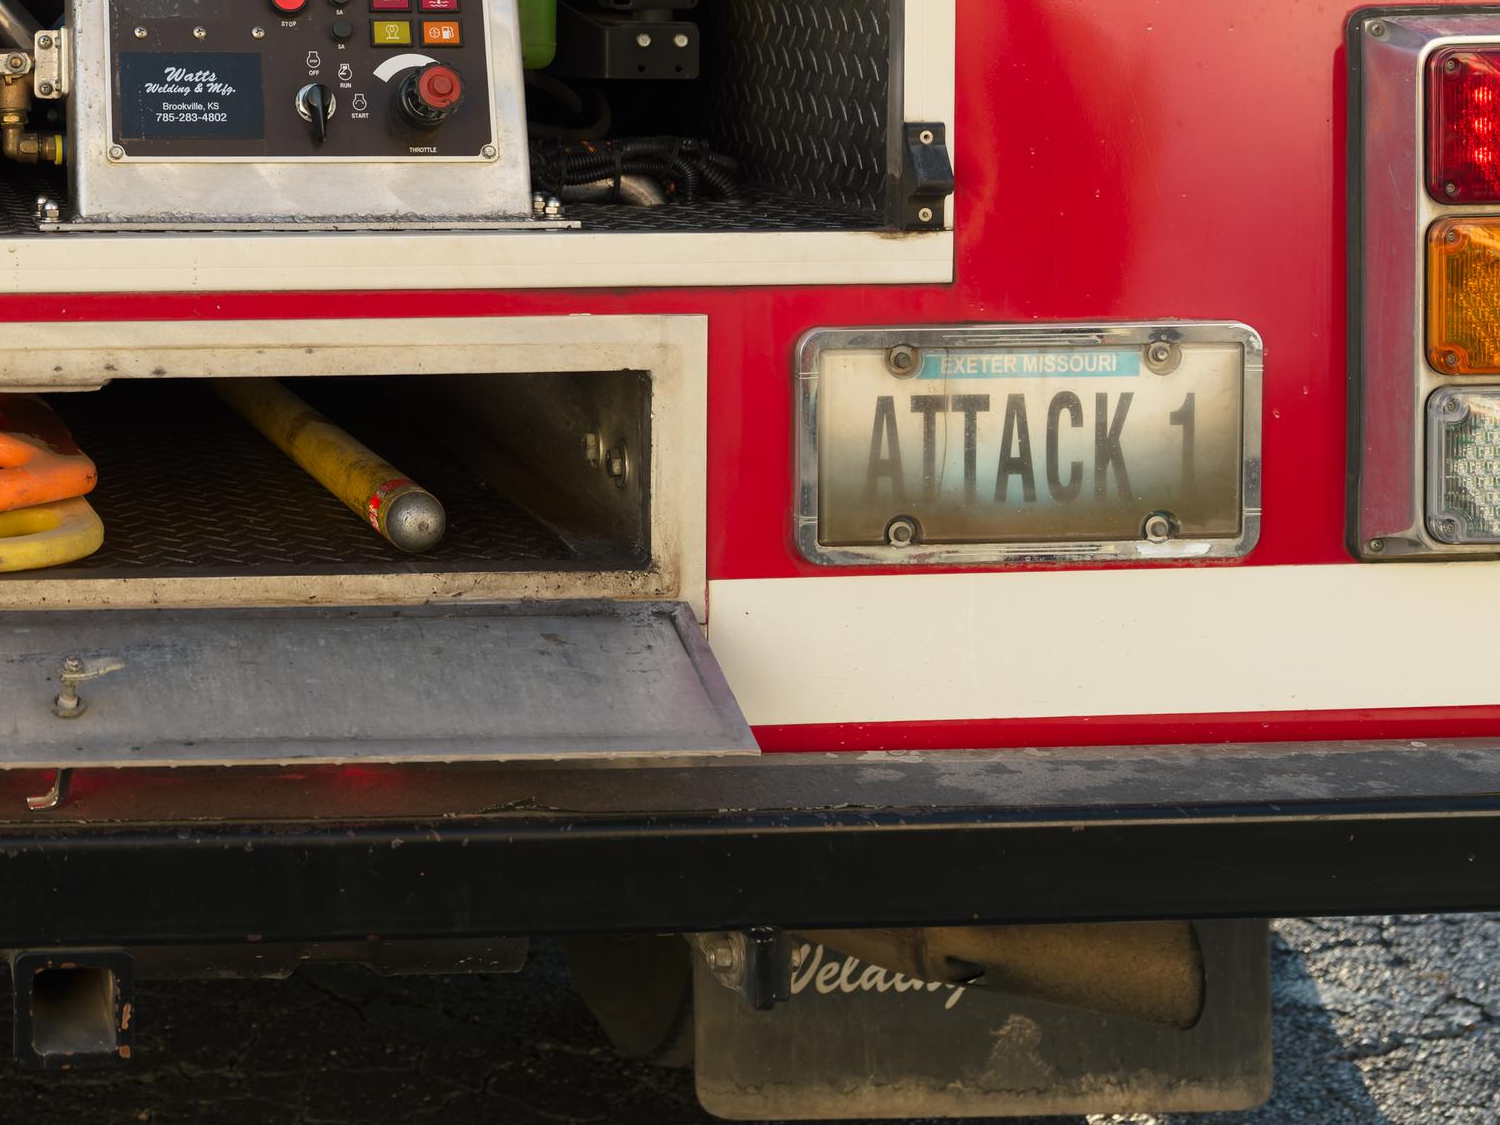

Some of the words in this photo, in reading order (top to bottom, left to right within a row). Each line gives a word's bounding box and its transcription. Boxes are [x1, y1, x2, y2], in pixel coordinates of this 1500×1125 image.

[164, 66, 217, 82] Watts
[144, 83, 191, 96] Welding
[194, 83, 203, 93] &
[206, 83, 236, 96] Mfg.
[162, 102, 206, 111] Brookville,
[207, 102, 220, 110] KS
[155, 112, 228, 122] 785-283-4802
[939, 355, 1018, 375] EXETER
[1022, 354, 1118, 374] MISSOURI
[862, 390, 1137, 505] ATTACK
[1169, 391, 1197, 503] 1
